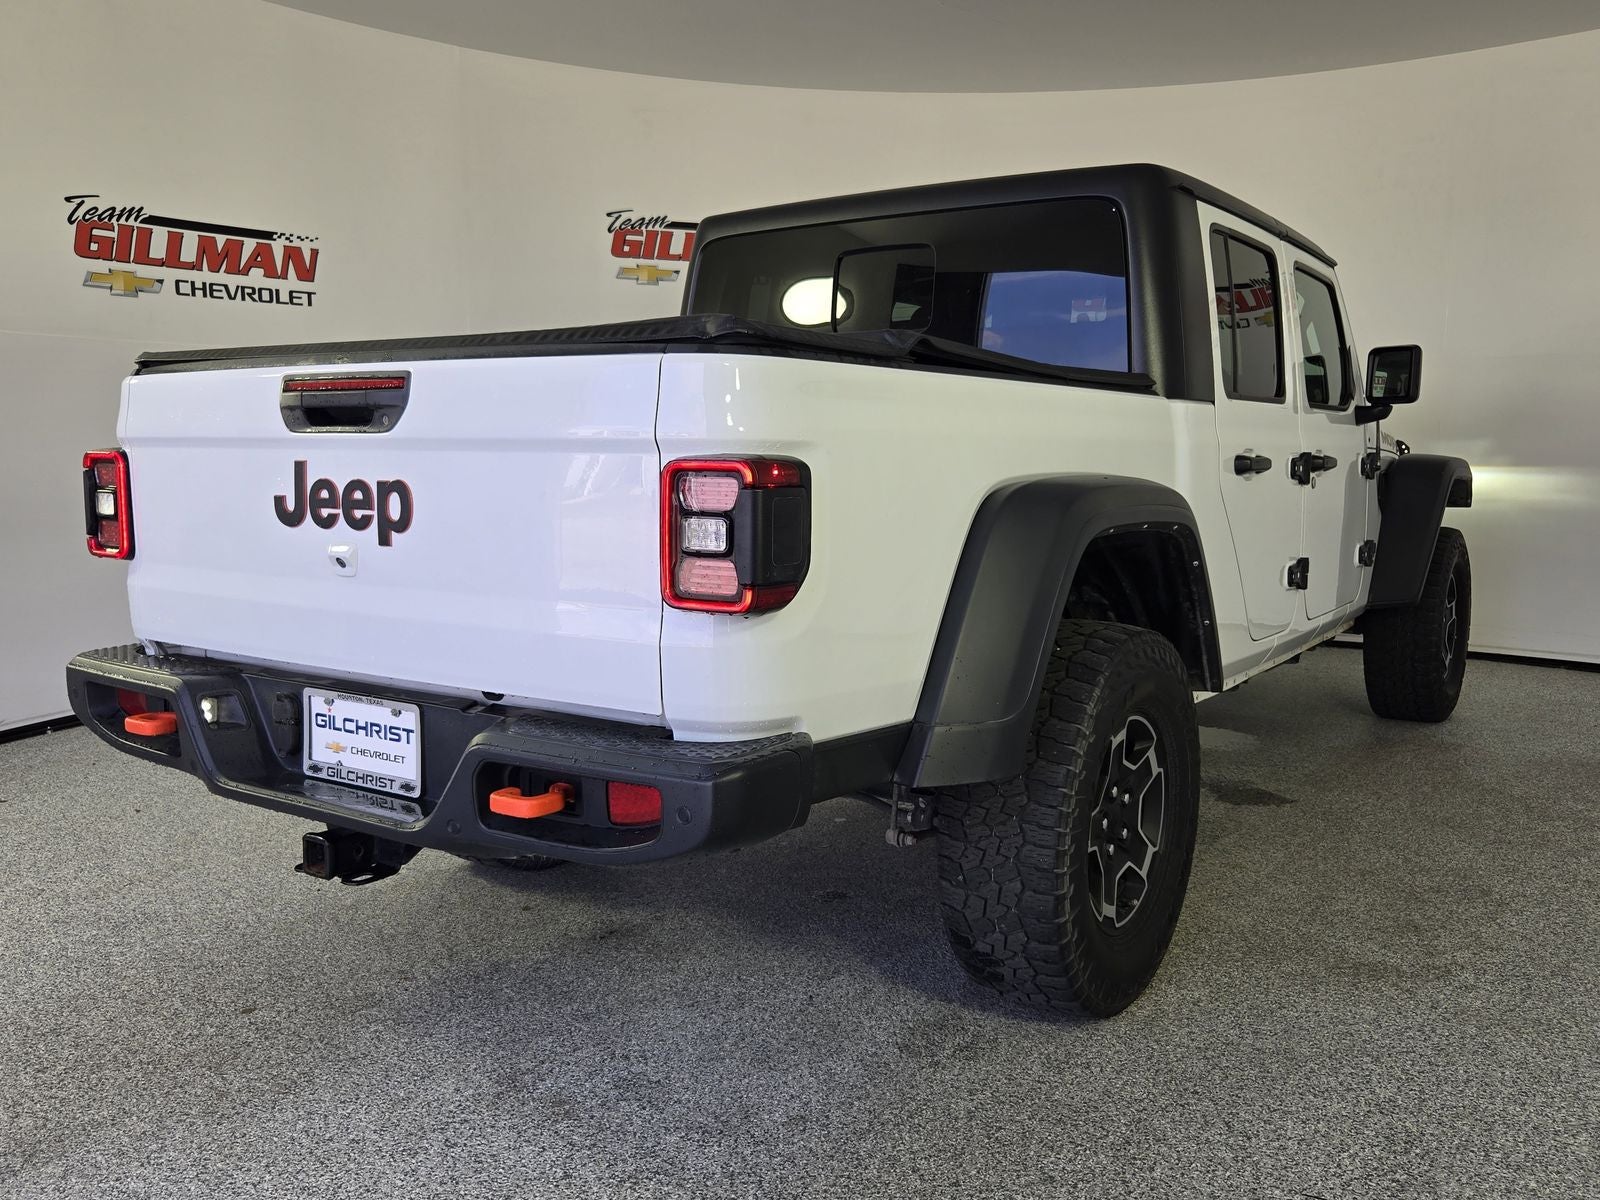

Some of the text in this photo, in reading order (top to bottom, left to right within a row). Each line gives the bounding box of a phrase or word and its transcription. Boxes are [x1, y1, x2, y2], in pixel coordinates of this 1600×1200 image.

[64, 194, 148, 225] Team
[606, 209, 669, 234] Team
[74, 220, 320, 282] GILLMAN
[174, 279, 317, 307] CHEVROLET
[273, 460, 414, 547] Jeep
[315, 712, 415, 745] GILCHRIST
[350, 746, 406, 764] CHEVROLET
[326, 766, 397, 790] GILCHRIST
